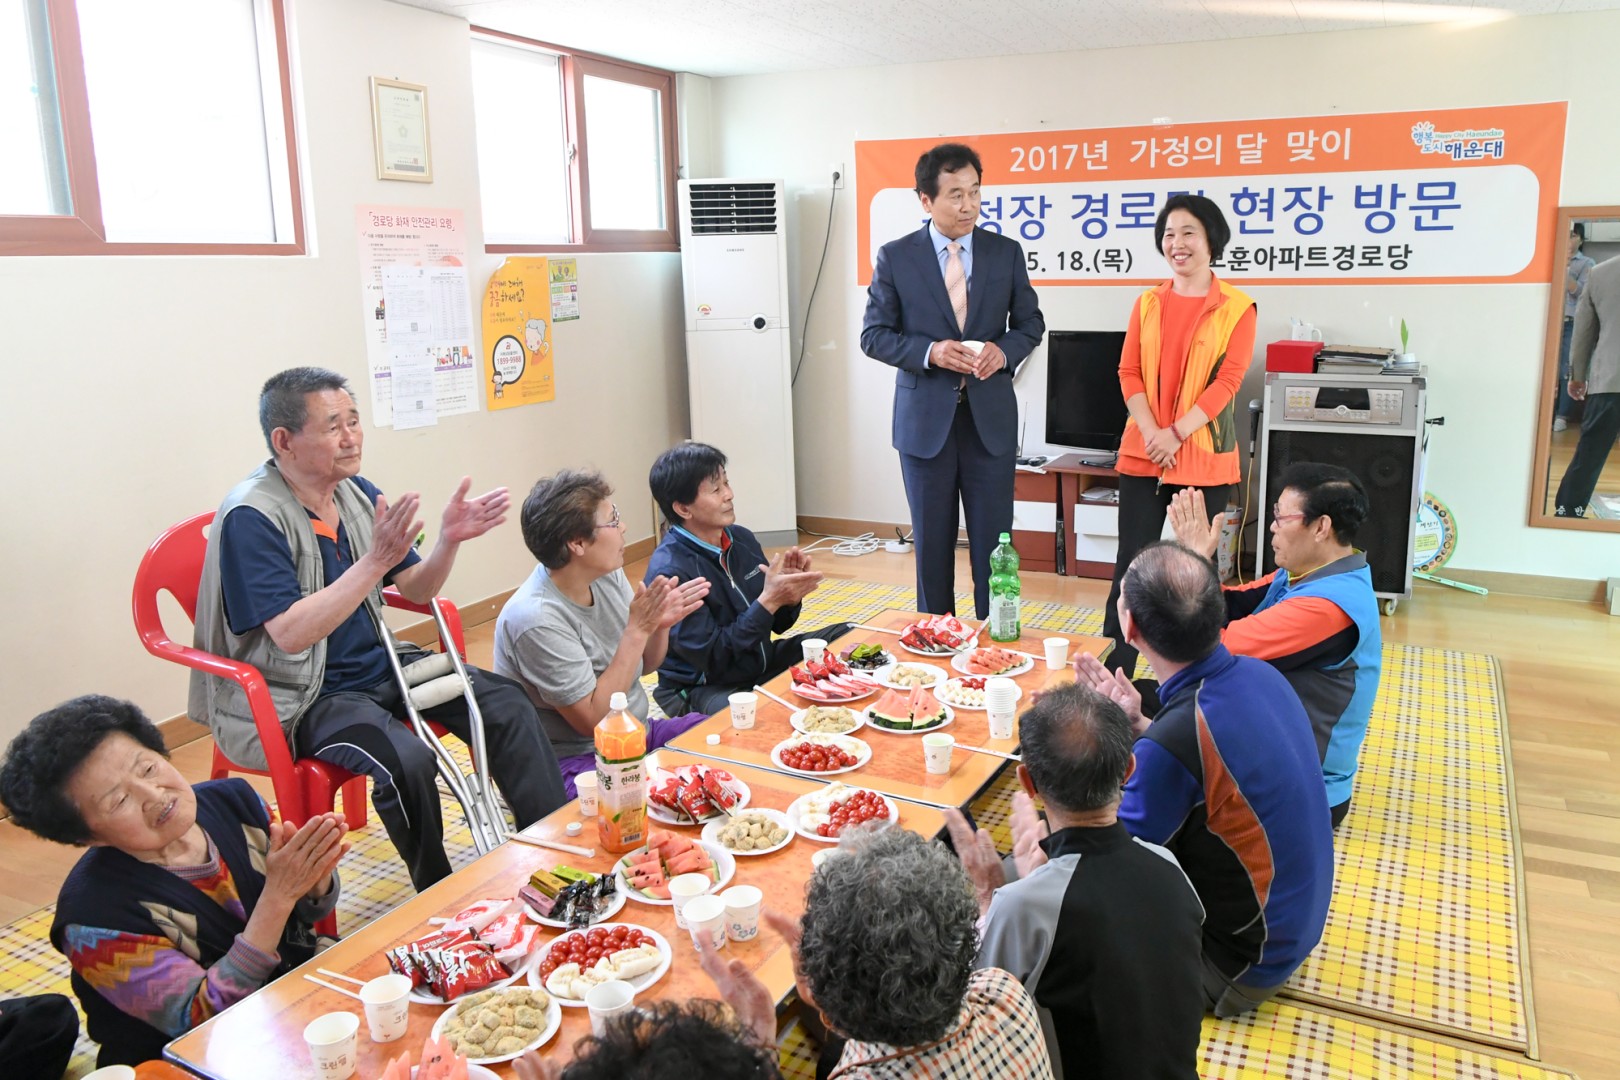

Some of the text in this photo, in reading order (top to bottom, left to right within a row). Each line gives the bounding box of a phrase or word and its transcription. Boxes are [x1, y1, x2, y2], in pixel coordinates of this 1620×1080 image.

[1413, 131, 1434, 144] 행복
[1466, 129, 1503, 138] Haeundae
[1010, 128, 1351, 172] 2017년 가정의 달 맞이
[1445, 141, 1503, 159] 해운대
[1230, 185, 1333, 235] 현장
[1354, 181, 1461, 234] 방문
[396, 216, 410, 228] 화재
[411, 216, 438, 229] 안전관리
[497, 355, 521, 365] 1899-9988
[621, 773, 641, 786] 한라봉
